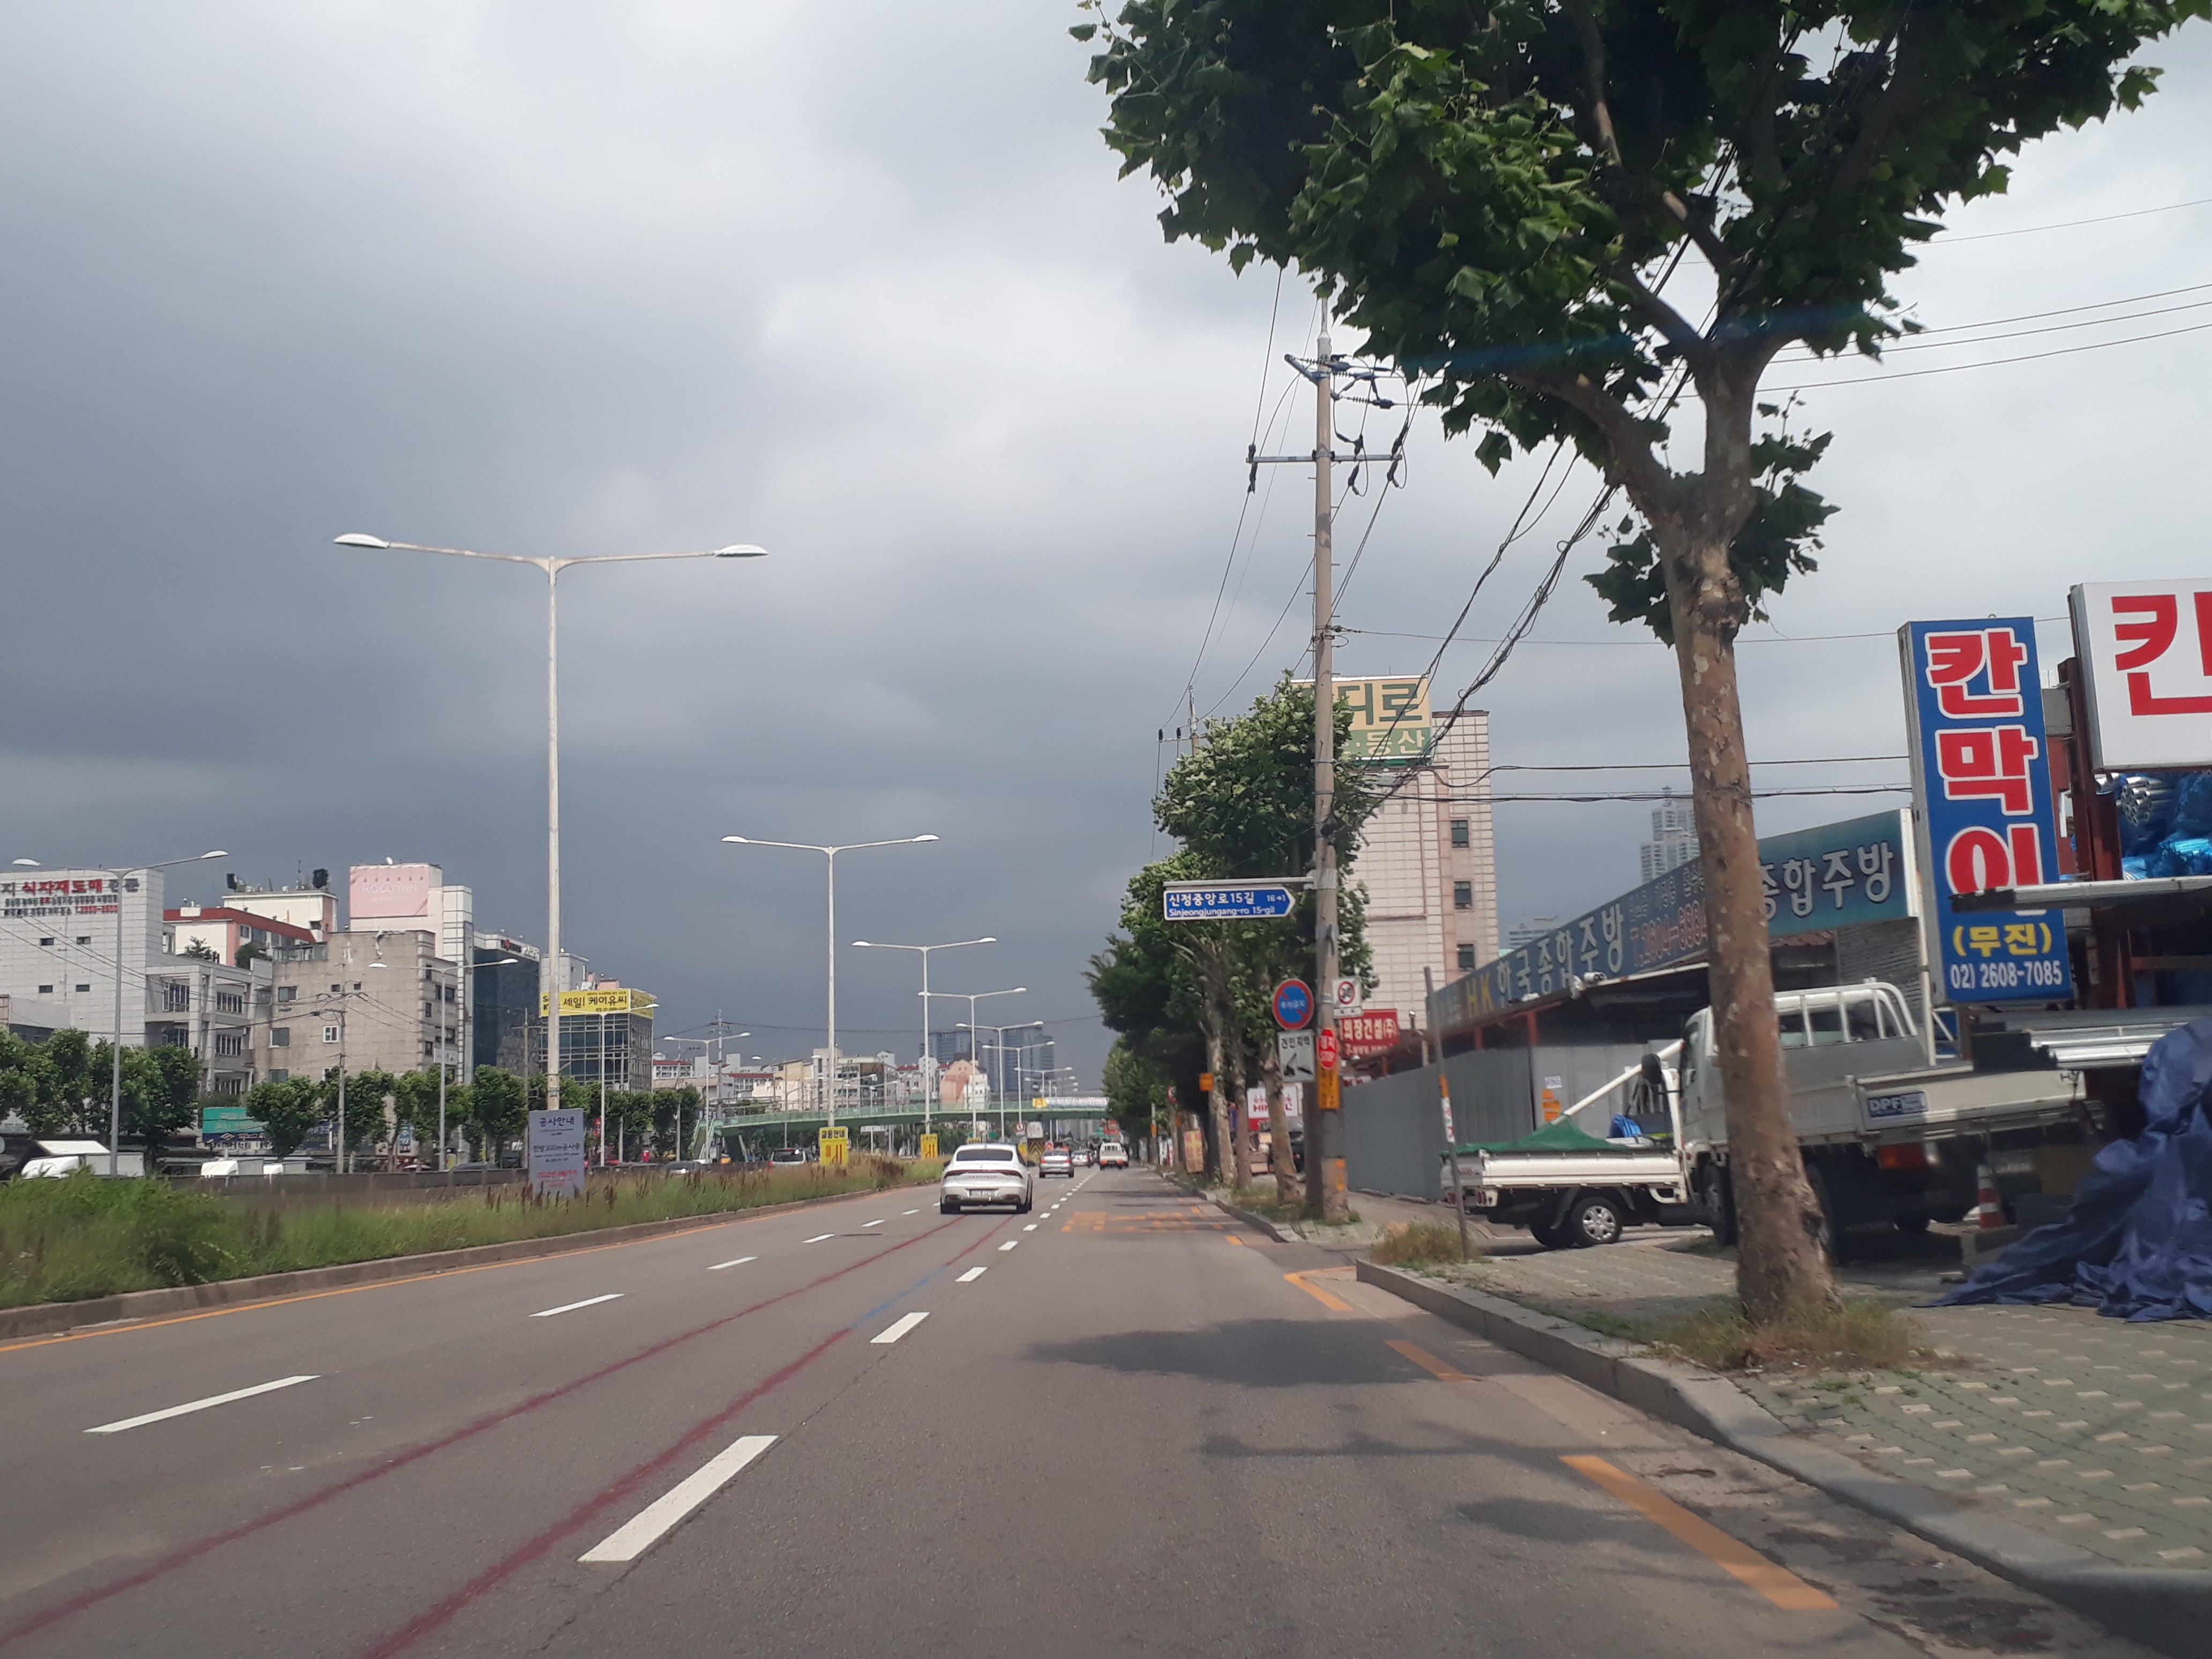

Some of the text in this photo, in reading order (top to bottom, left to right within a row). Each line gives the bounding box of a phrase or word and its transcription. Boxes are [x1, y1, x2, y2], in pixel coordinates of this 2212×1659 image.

[1299, 683, 1423, 726] 디로
[1925, 627, 2043, 915] 칸막이
[1169, 891, 1254, 907] 신정중앙로15길
[1169, 906, 1275, 917] Sinjeongjungang-ro 15-gil
[1952, 922, 2052, 958] (무진)
[1497, 902, 1625, 1009] 한국종합주방
[1951, 960, 2063, 989] 02) 2608-7085
[588, 995, 627, 1006] 케이유씨
[1281, 1035, 1311, 1049] 견인지역
[539, 1116, 574, 1127] 공사안내
